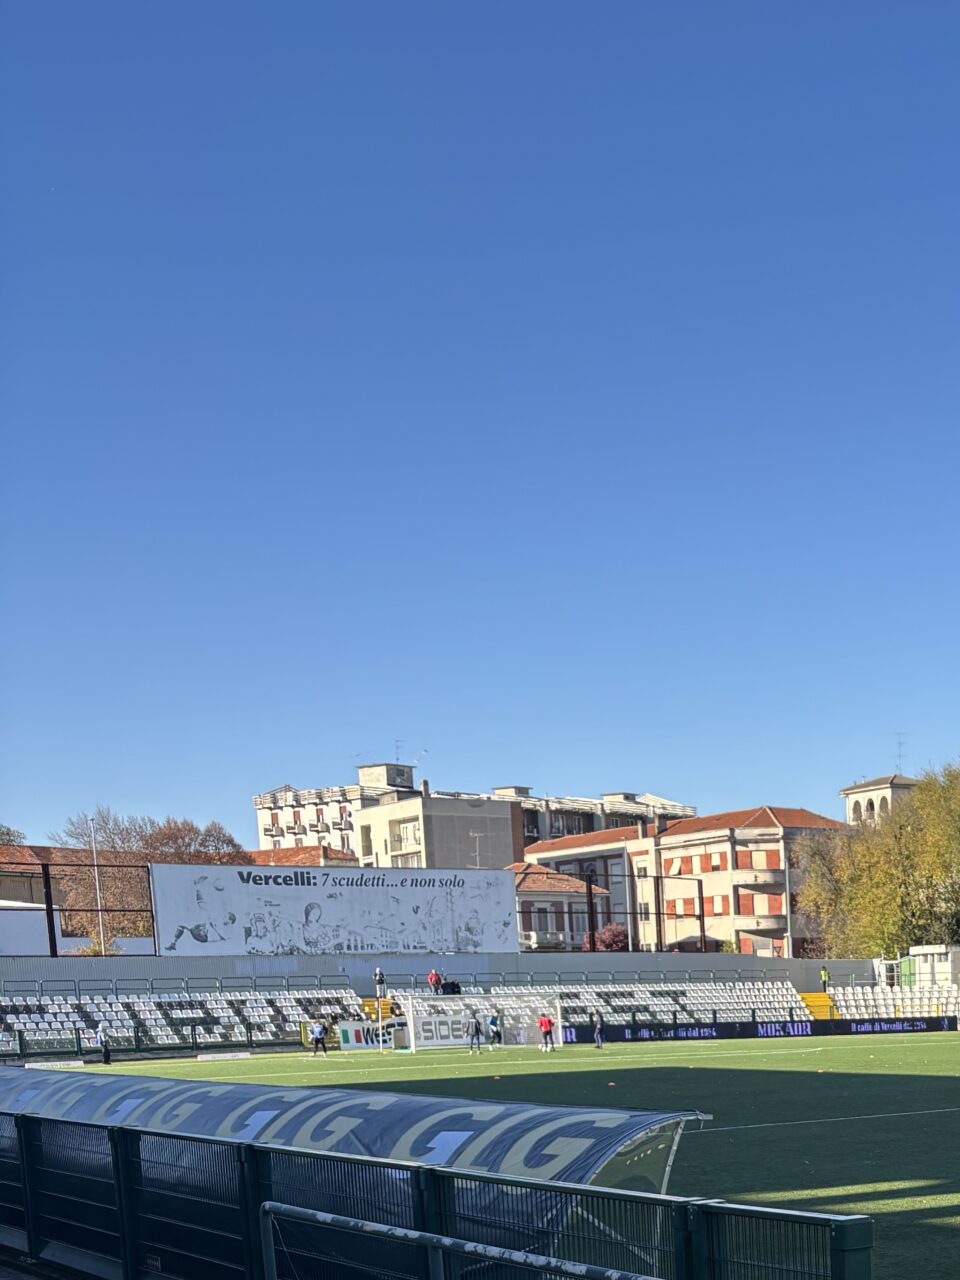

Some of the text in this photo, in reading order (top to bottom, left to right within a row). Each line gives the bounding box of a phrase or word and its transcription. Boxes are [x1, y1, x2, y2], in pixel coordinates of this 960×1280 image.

[238, 871, 317, 887] Vercelli:
[321, 873, 330, 887] 7
[410, 877, 436, 888] non
[438, 874, 465, 888] solo
